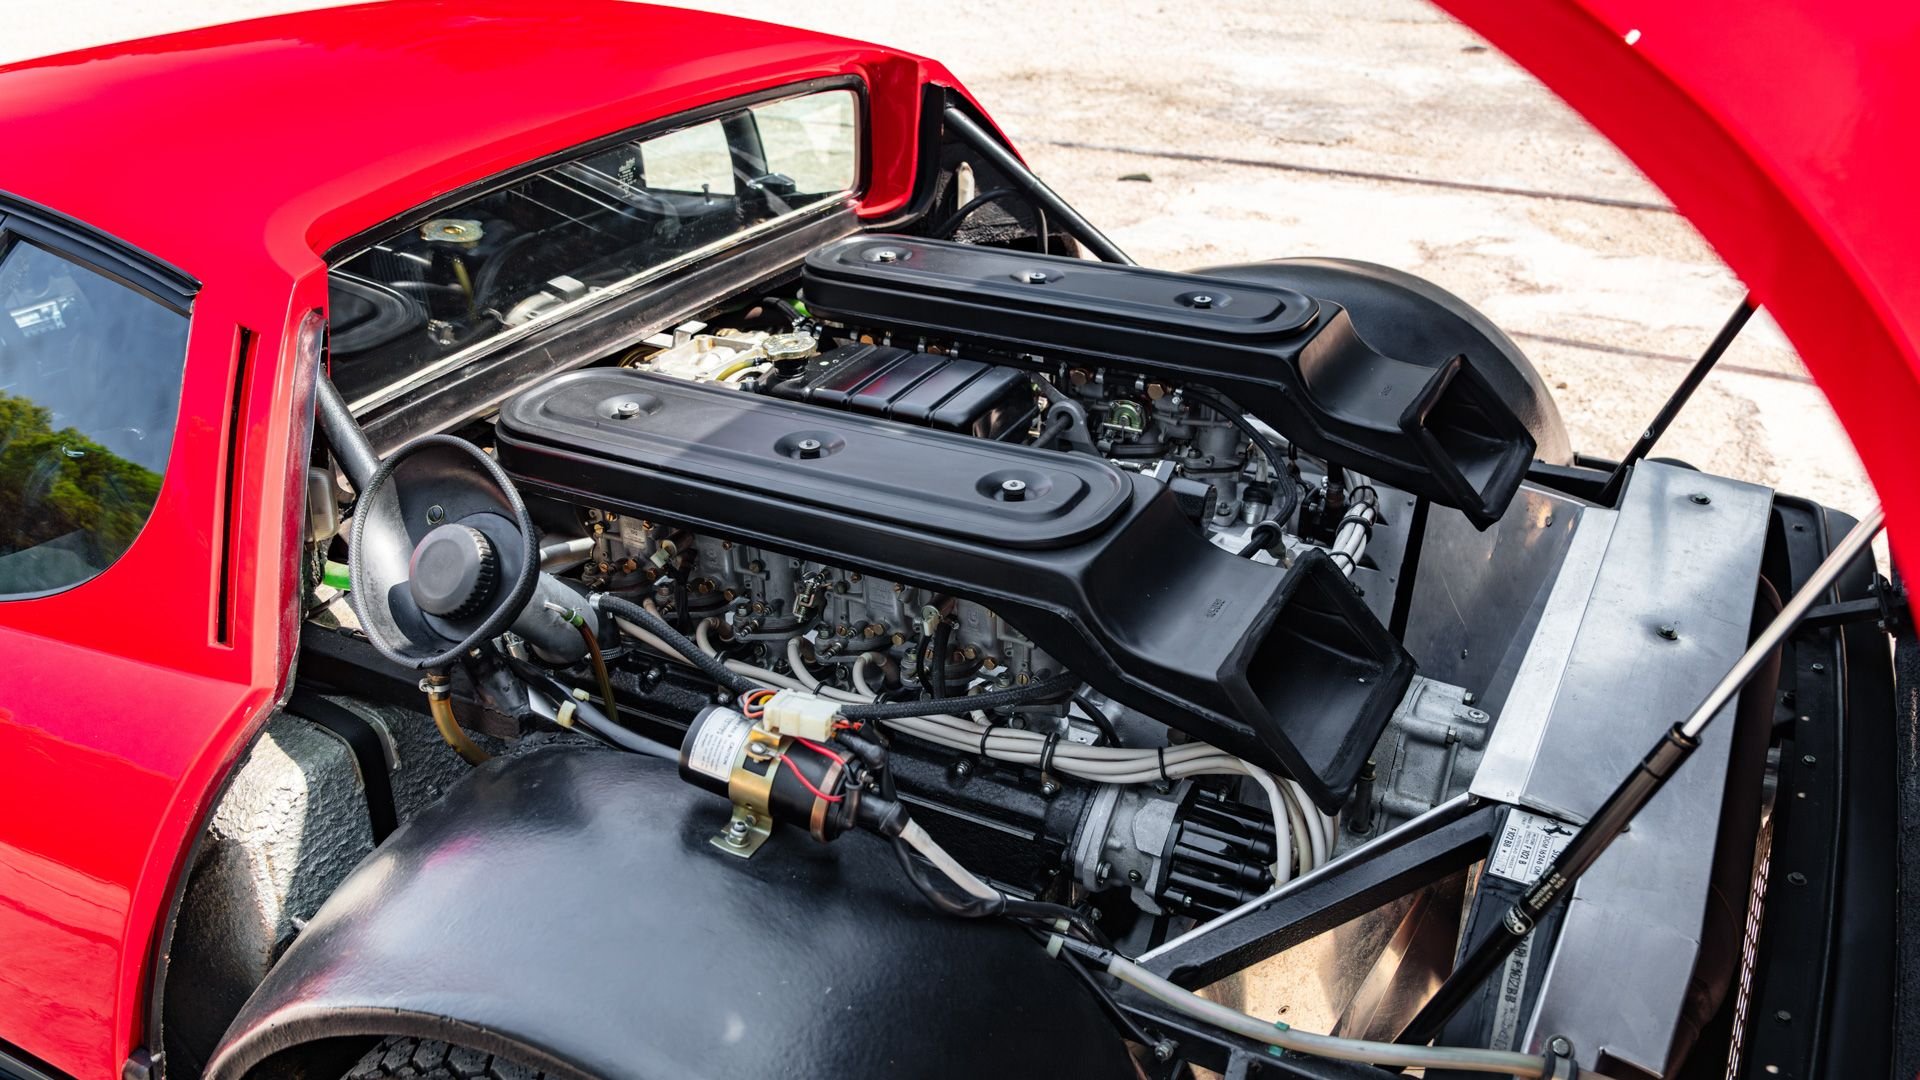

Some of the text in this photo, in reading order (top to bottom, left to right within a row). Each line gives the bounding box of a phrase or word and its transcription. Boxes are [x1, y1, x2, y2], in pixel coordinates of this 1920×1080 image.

[1542, 836, 1551, 848] DGM
[1536, 848, 1546, 865] 16246
[1549, 872, 1561, 884] ALTA
[1554, 876, 1567, 889] NON
